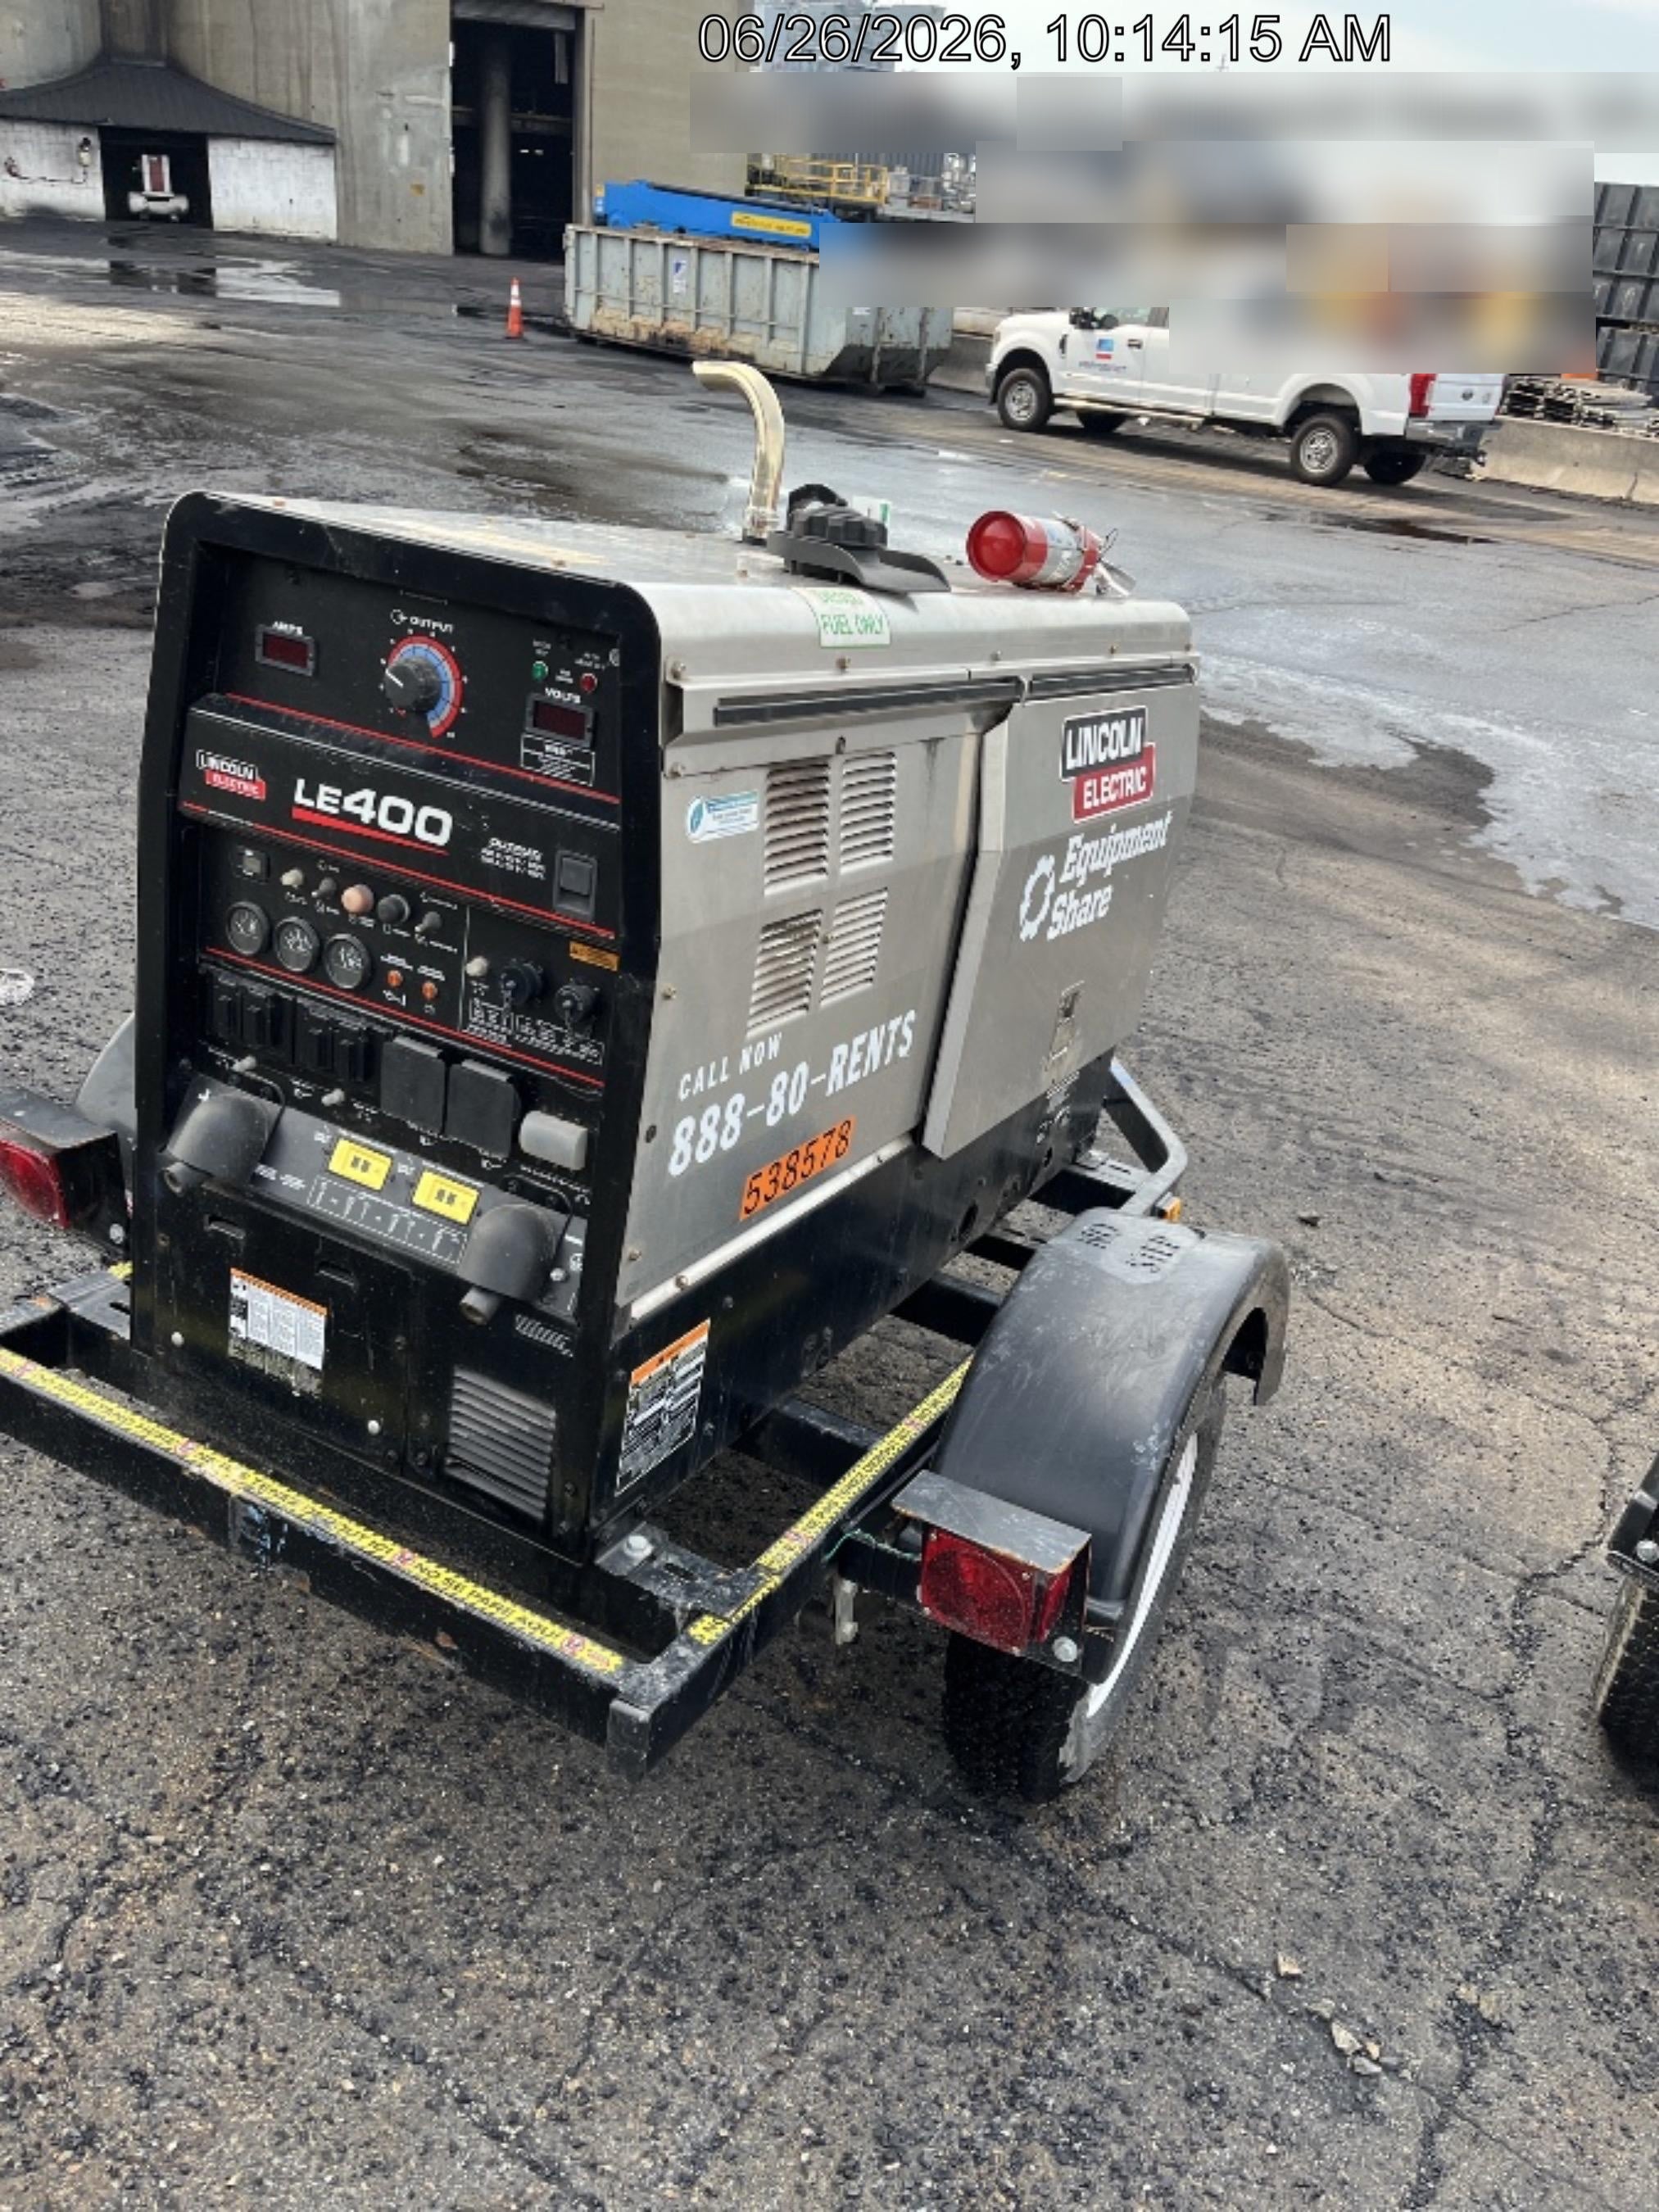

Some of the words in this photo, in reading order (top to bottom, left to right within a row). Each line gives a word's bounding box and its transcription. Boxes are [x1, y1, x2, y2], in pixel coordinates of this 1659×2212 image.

[410, 616, 454, 632] OUTPUT
[821, 614, 854, 635] FUEL
[201, 752, 254, 780] LINCOLN
[1066, 716, 1144, 770] LINCOLN
[294, 778, 452, 846] LE400
[1083, 766, 1147, 809] ELECTRIC
[1058, 810, 1173, 887] Equipment
[1047, 884, 1113, 941] Share
[668, 1009, 917, 1177] 888-80-RENTS
[678, 1056, 729, 1110] CALL
[739, 1032, 782, 1084] NOW
[743, 1119, 853, 1216] 538578
